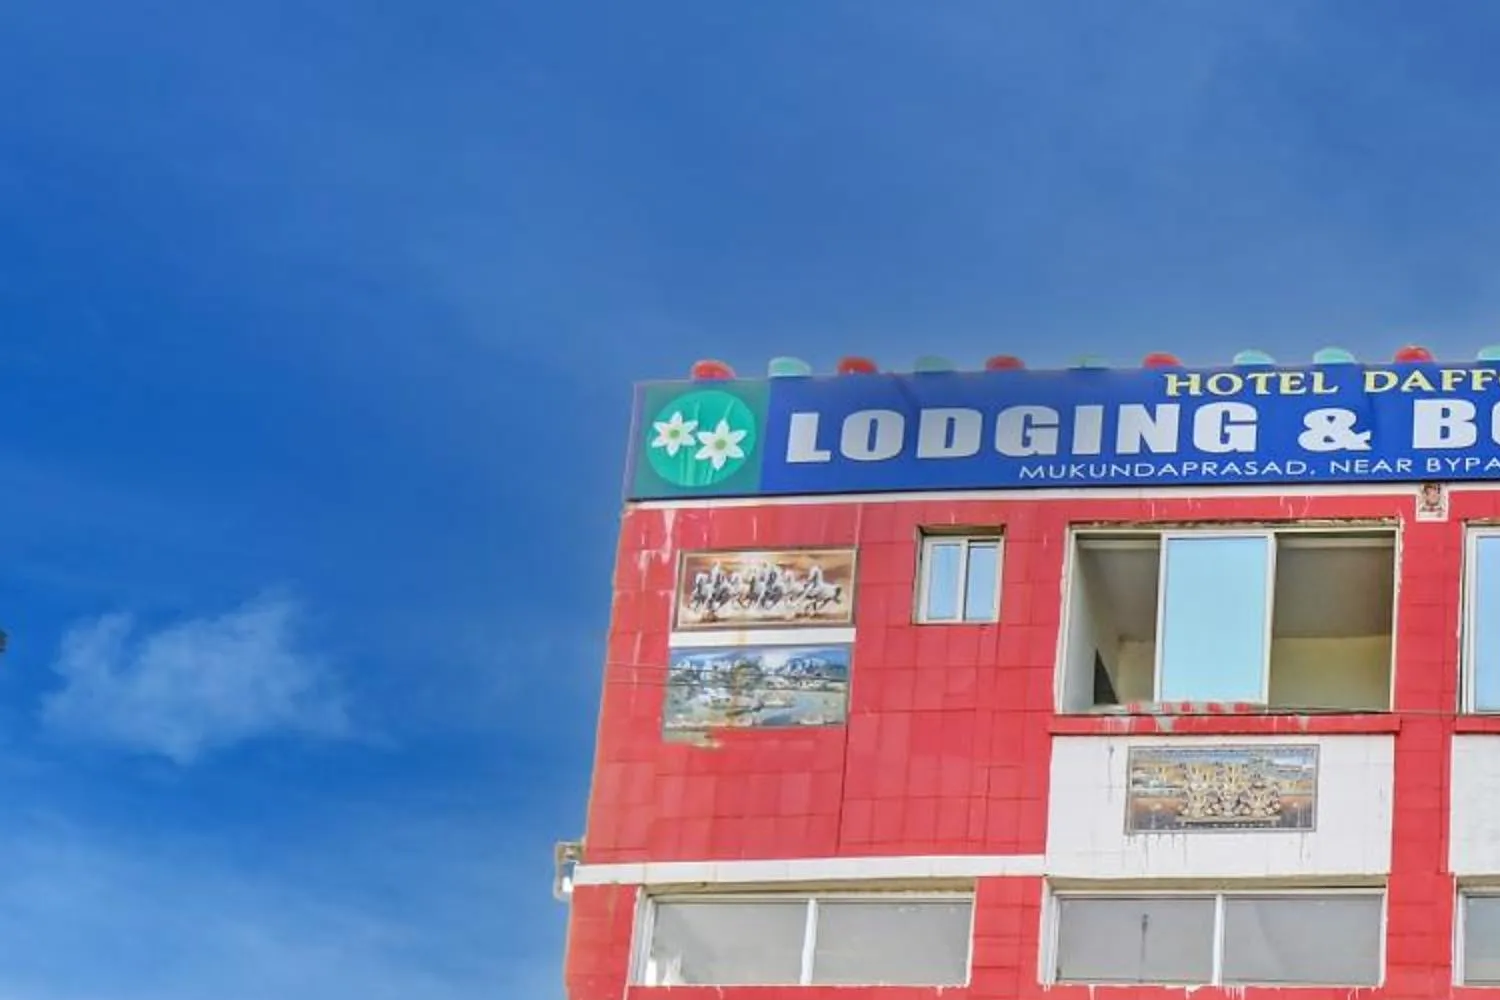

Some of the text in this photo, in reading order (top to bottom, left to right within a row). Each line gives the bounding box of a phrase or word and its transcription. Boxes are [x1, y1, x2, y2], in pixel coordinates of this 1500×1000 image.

[1165, 371, 1338, 396] HOTEL
[786, 401, 1258, 463] LODGING
[1299, 408, 1371, 452] &
[1331, 458, 1411, 474] NEAR
